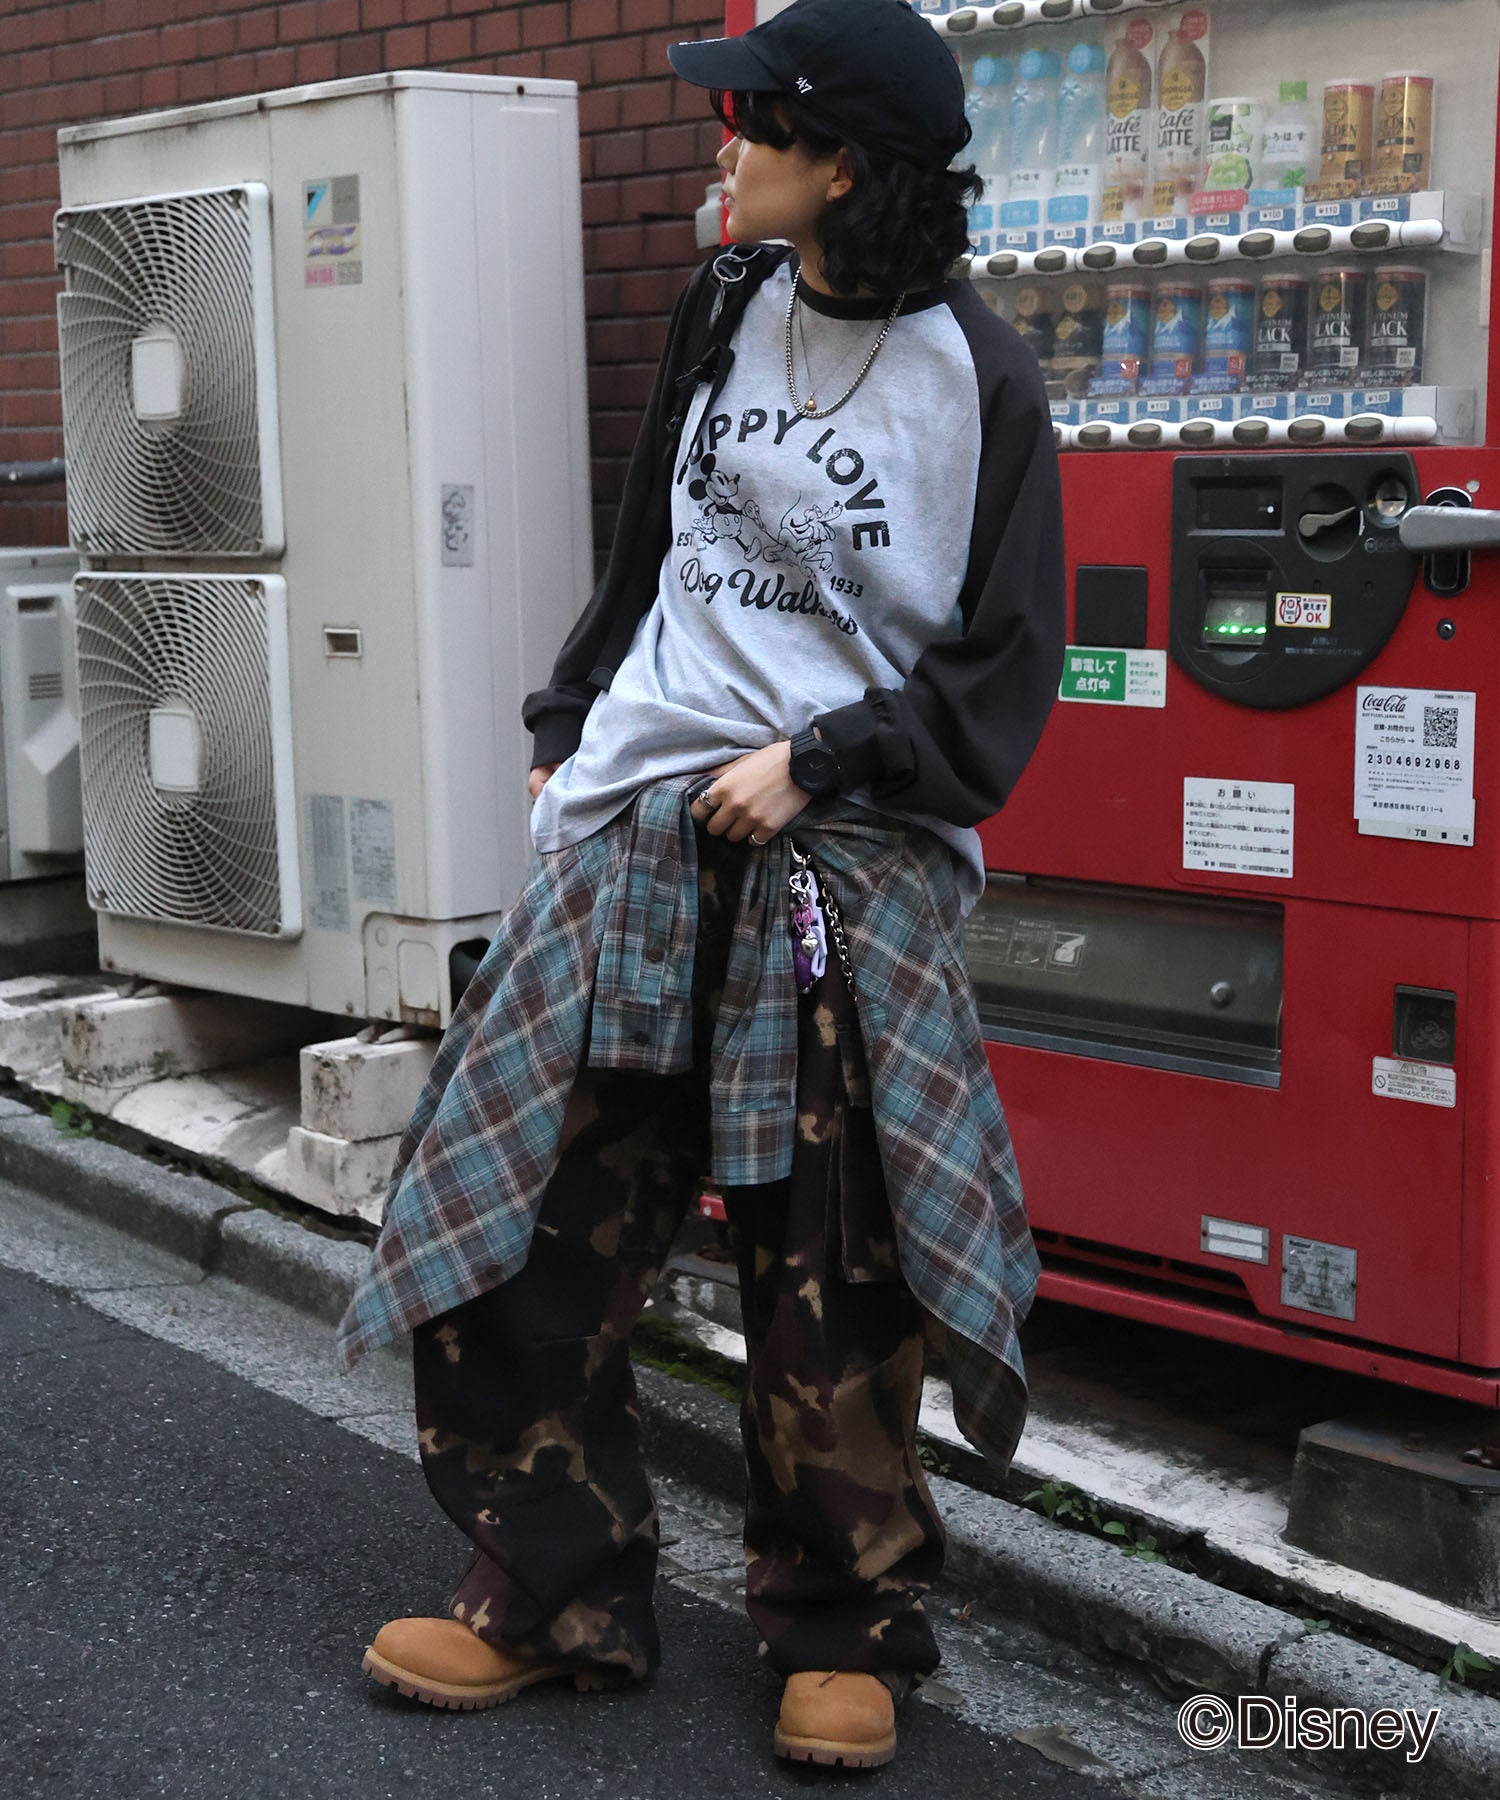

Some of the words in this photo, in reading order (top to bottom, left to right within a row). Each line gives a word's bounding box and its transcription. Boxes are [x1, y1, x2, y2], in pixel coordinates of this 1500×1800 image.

[1107, 115, 1141, 136] Café
[1159, 109, 1194, 129] Café
[1258, 327, 1291, 342] LACK
[1315, 320, 1351, 336] LACK
[1372, 320, 1407, 336] LACK
[806, 427, 891, 551] LOVE
[830, 576, 864, 597] 1933
[1303, 602, 1327, 611] 使えます
[1306, 612, 1322, 623] OK
[1071, 657, 1117, 674] 節電して
[1075, 677, 1111, 693] 点灯中
[1380, 736, 1406, 744] こちらから
[1414, 828, 1427, 837] 丁目
